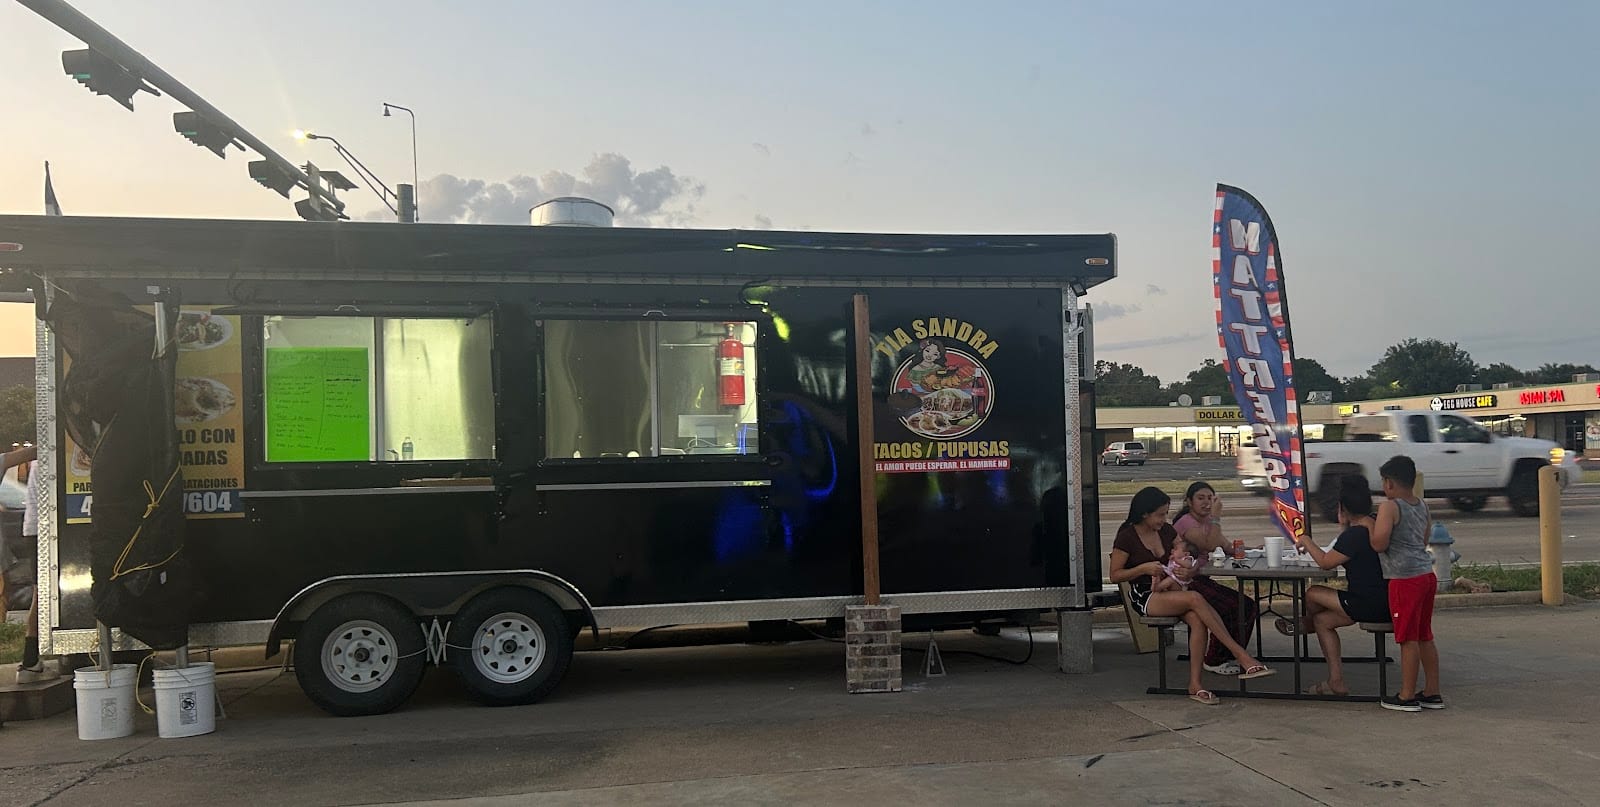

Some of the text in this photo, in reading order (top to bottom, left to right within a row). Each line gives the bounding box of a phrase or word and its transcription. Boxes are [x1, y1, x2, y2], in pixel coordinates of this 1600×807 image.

[875, 317, 1000, 360] TIA SANDRA
[1443, 395, 1493, 409] EGG HOUSE CAFE
[1519, 389, 1565, 405] ASIAN SPA
[1200, 411, 1234, 419] DOLLAR
[201, 428, 235, 444] CON
[874, 442, 923, 459] TACOS
[937, 440, 1009, 457] PUPUSAS
[181, 450, 228, 466] ADAS
[876, 463, 883, 471] EL
[884, 462, 904, 471] AMOR
[905, 461, 927, 470] PUEDE
[960, 460, 968, 469] EL
[968, 460, 997, 469] HAMBRE
[997, 460, 1008, 468] NO
